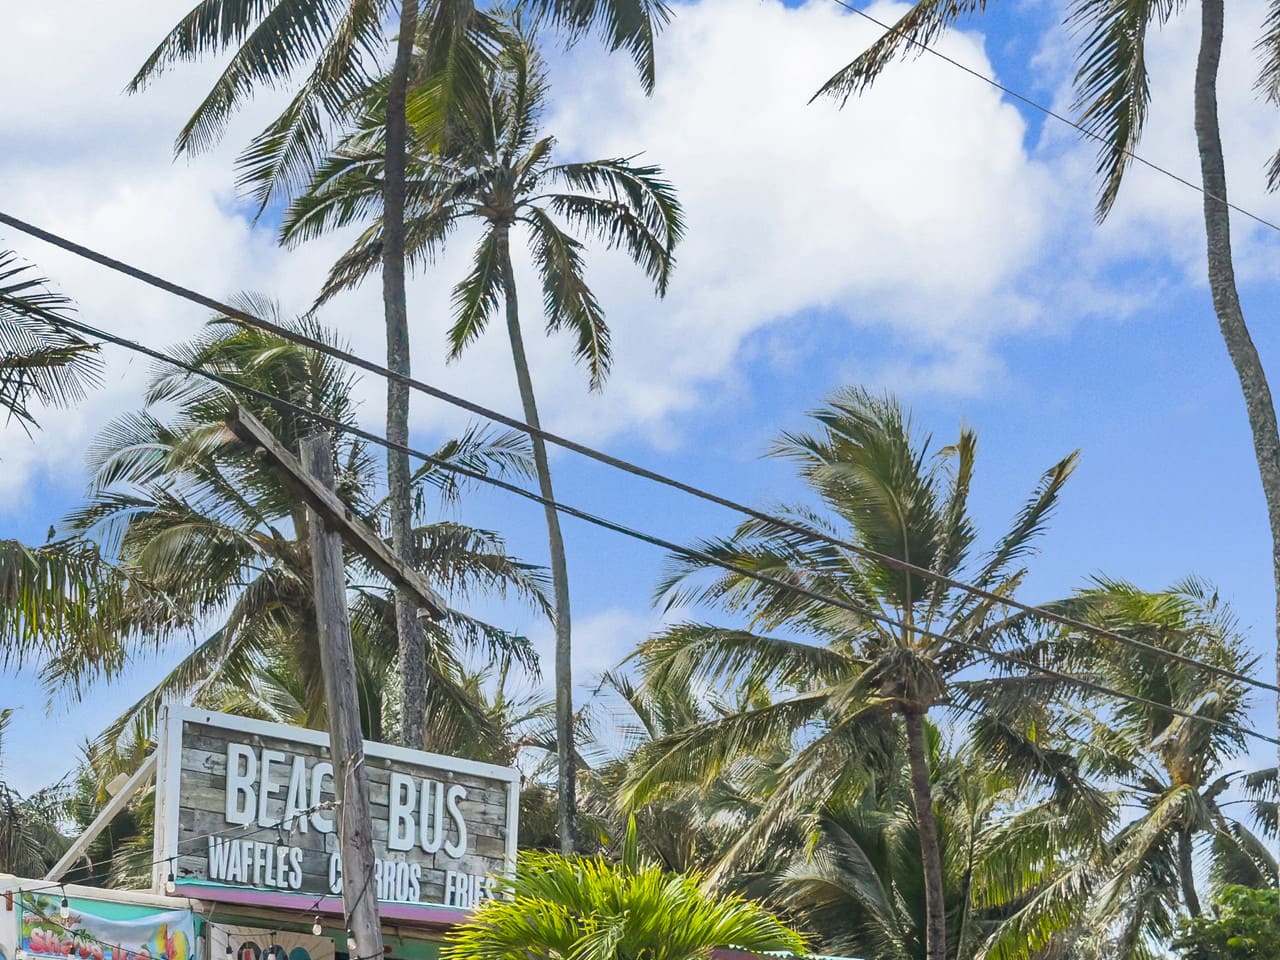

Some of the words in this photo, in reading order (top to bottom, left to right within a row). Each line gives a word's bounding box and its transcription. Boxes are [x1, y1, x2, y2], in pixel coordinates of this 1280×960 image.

[226, 742, 335, 834] BEAC
[387, 772, 468, 859] BUS
[208, 835, 303, 890] WAFFLES
[328, 853, 422, 902] CRROS
